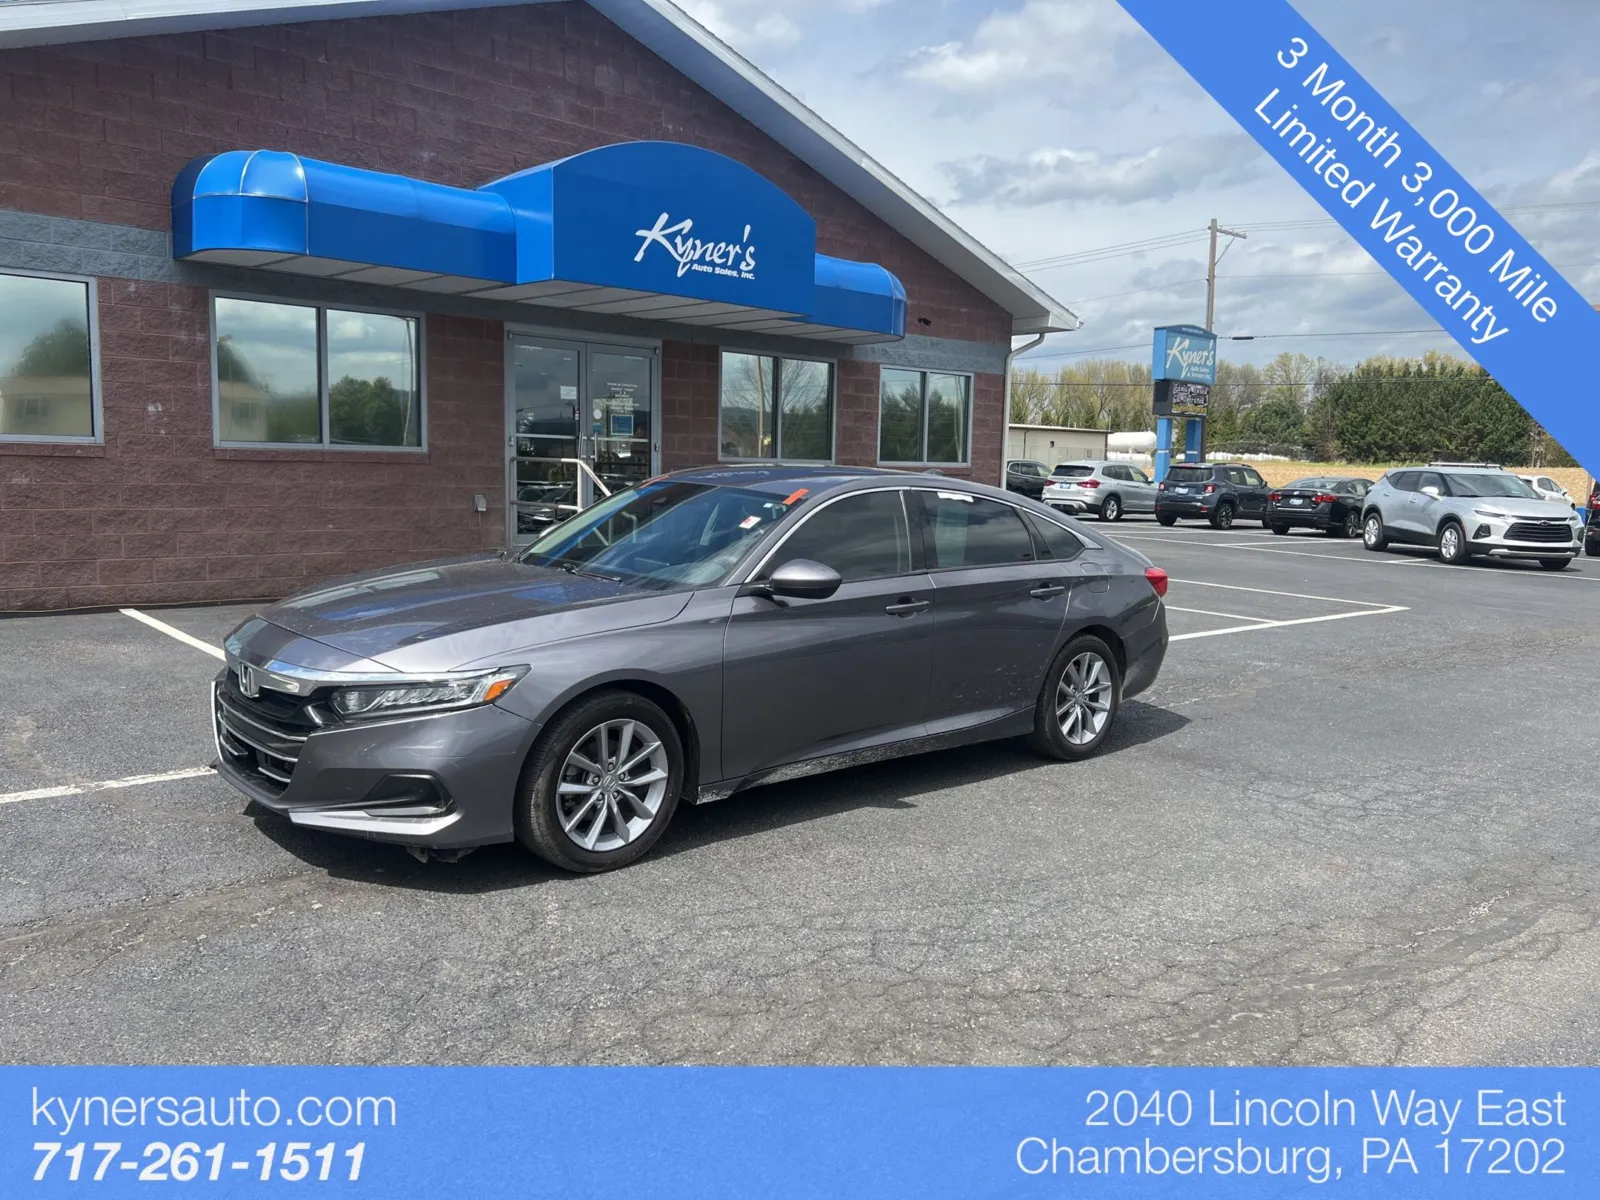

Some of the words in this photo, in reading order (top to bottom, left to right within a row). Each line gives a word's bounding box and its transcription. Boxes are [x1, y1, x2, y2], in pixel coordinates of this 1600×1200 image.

[633, 212, 756, 278] Kyner's
[691, 263, 713, 273] Auto
[714, 267, 739, 278] Sales,
[741, 271, 756, 280] Inc.
[1166, 337, 1214, 379] Kyner's
